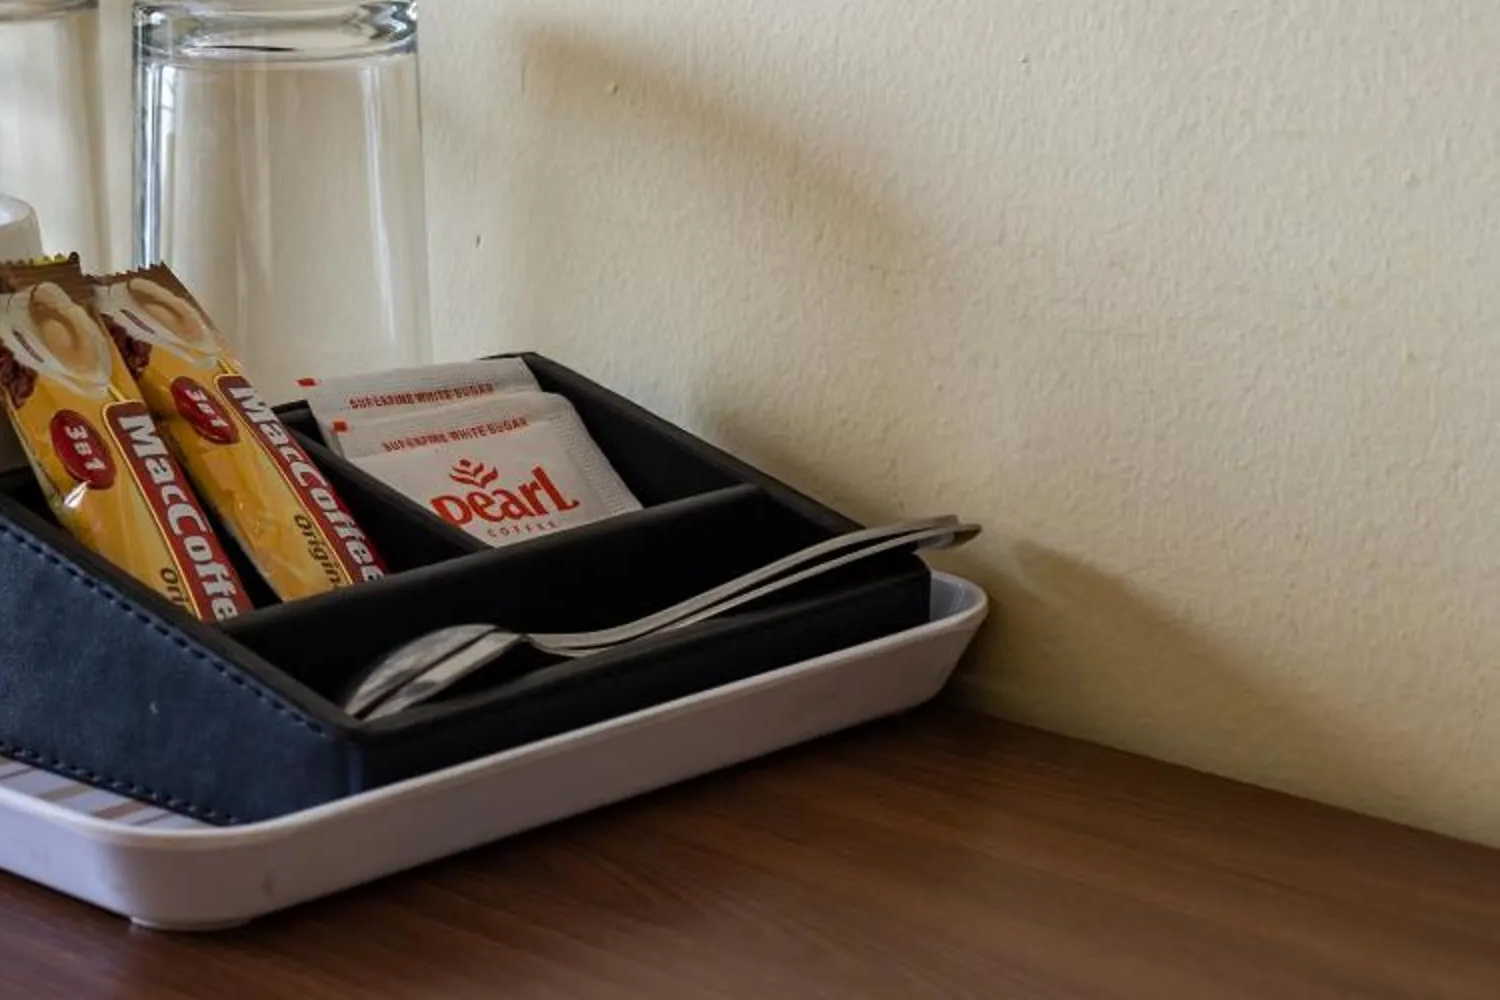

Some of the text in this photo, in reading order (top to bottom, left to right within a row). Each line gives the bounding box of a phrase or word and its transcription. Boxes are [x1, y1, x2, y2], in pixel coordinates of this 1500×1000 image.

[118, 414, 240, 620] MacCoffe
[227, 386, 385, 583] MacCoffee
[294, 514, 343, 584] Origin
[429, 466, 580, 528] pearl
